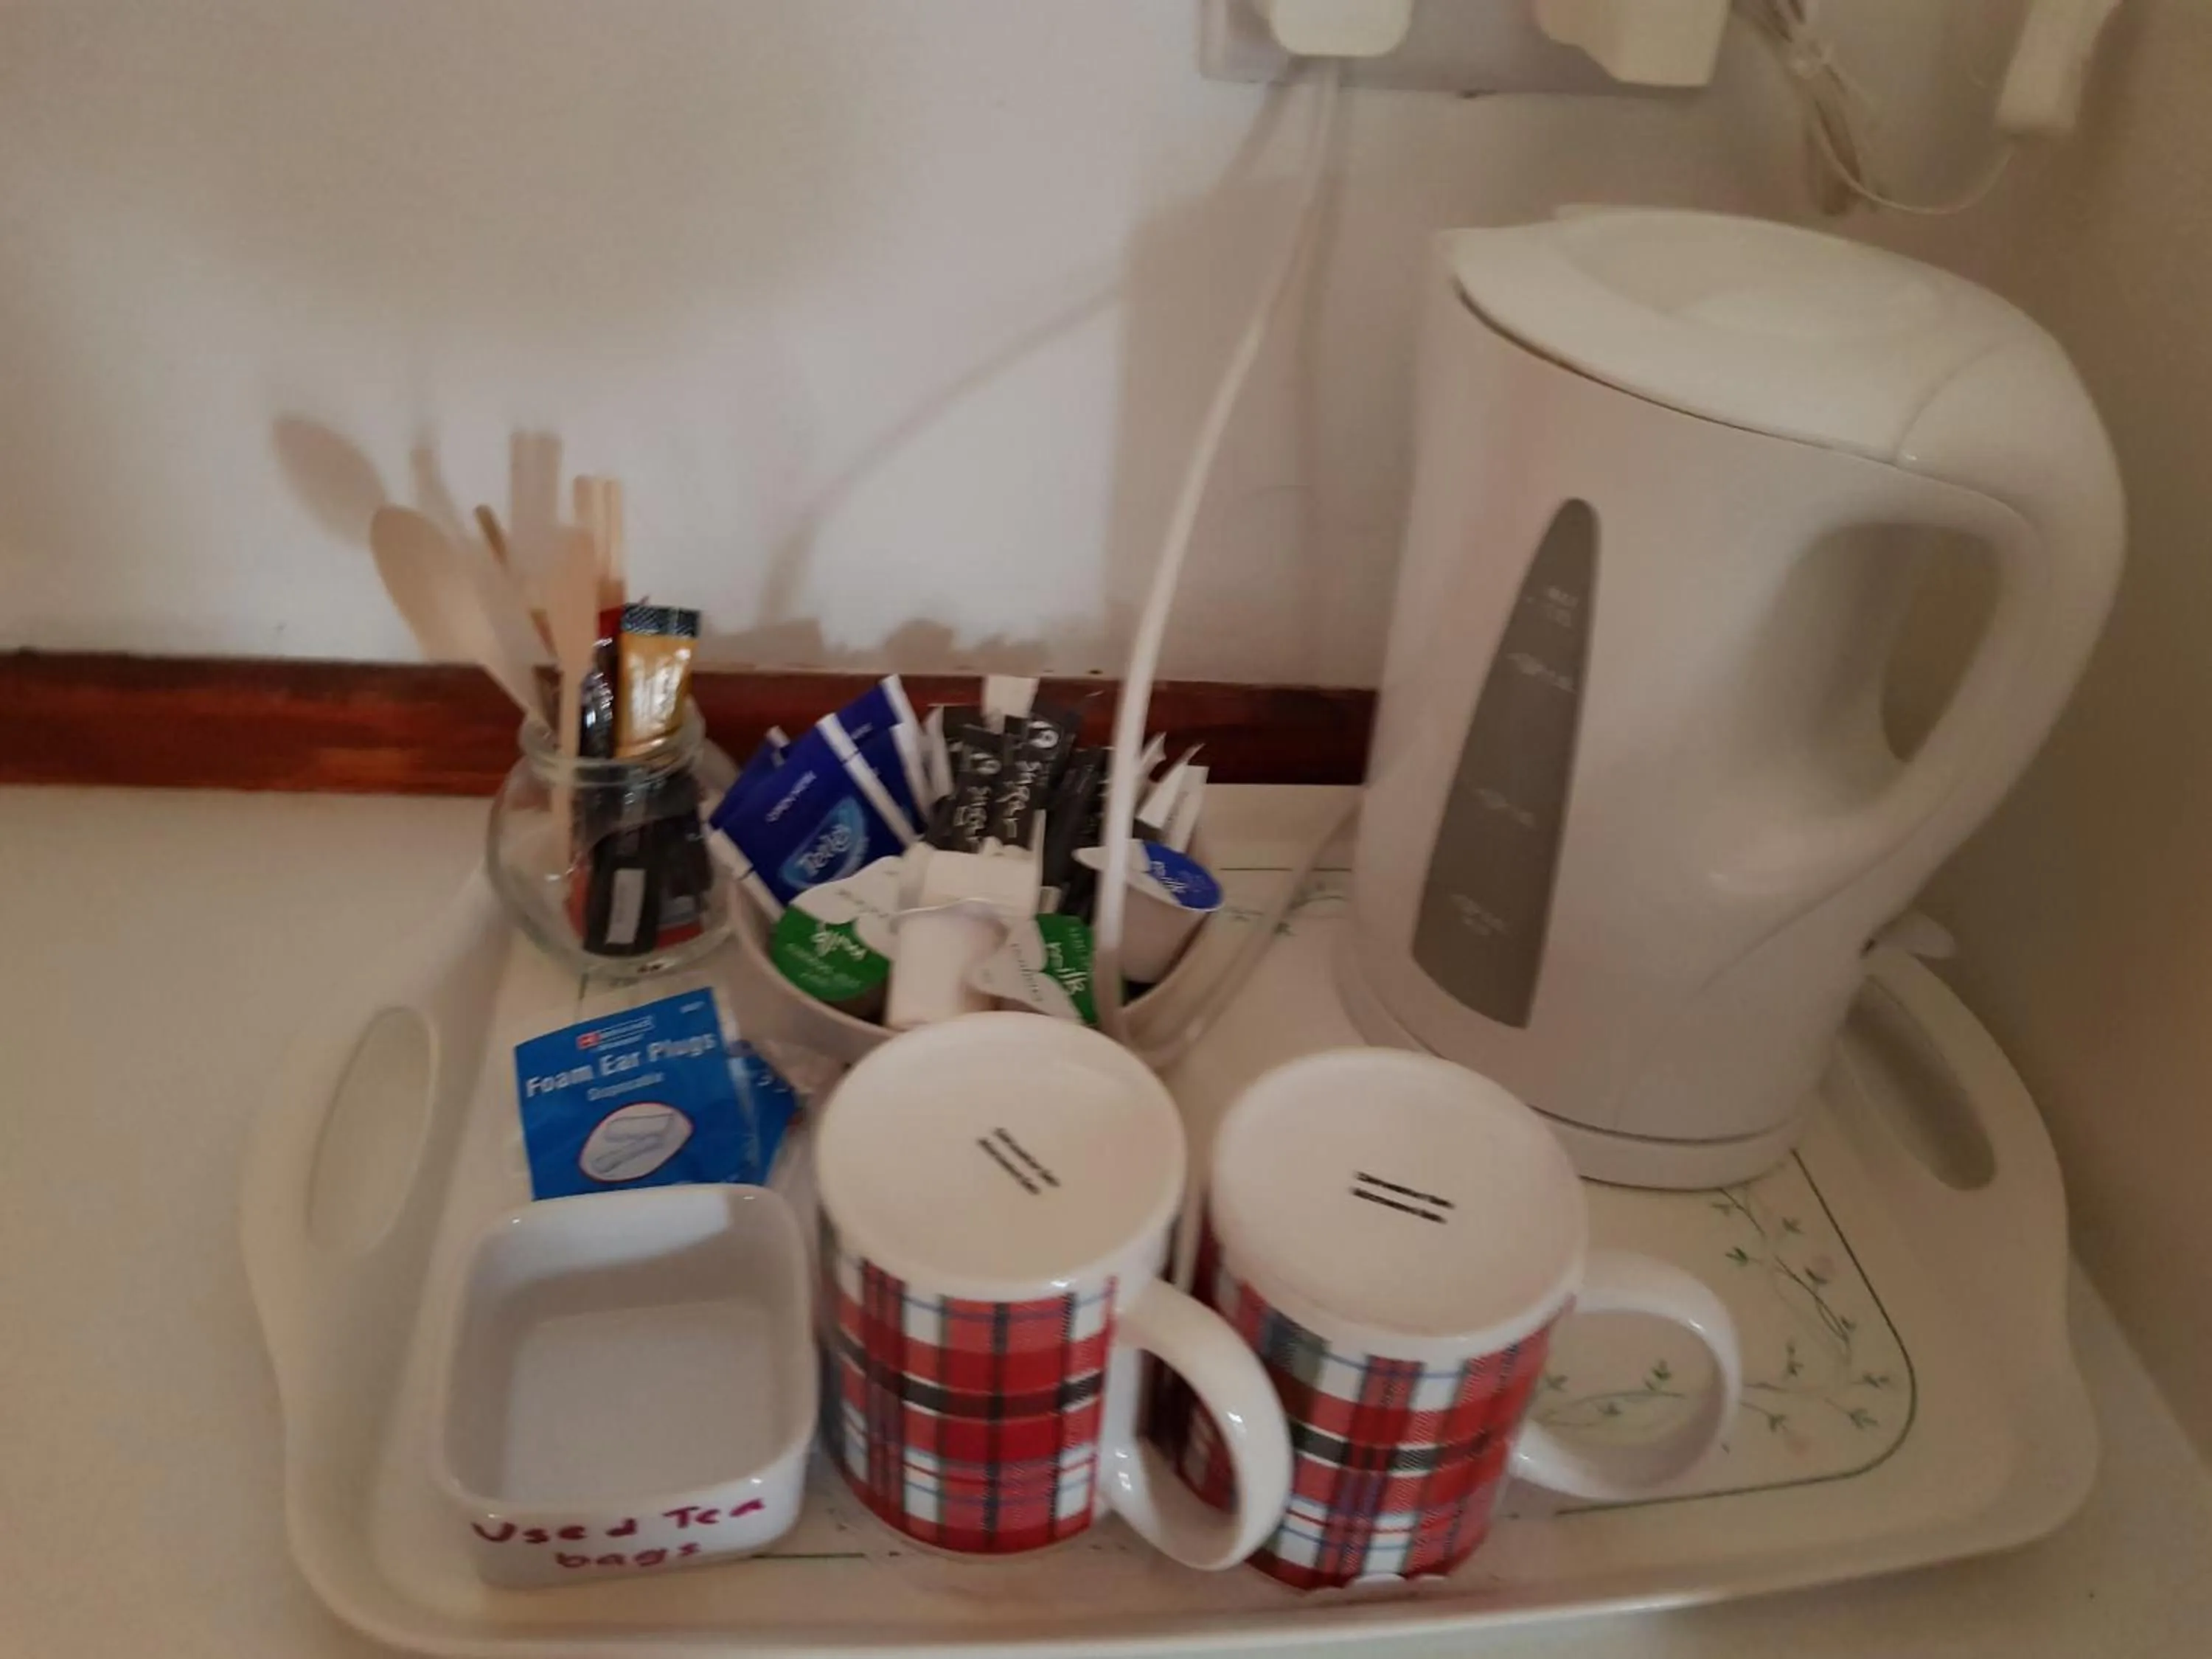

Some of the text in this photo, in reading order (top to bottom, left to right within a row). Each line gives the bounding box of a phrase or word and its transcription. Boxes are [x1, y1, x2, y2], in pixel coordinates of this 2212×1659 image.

[526, 1065, 594, 1098] Foam
[599, 1051, 641, 1076] Ear
[646, 1034, 717, 1062] Plugs
[472, 1498, 765, 1544] Used Tea
[555, 1543, 702, 1568] bags
